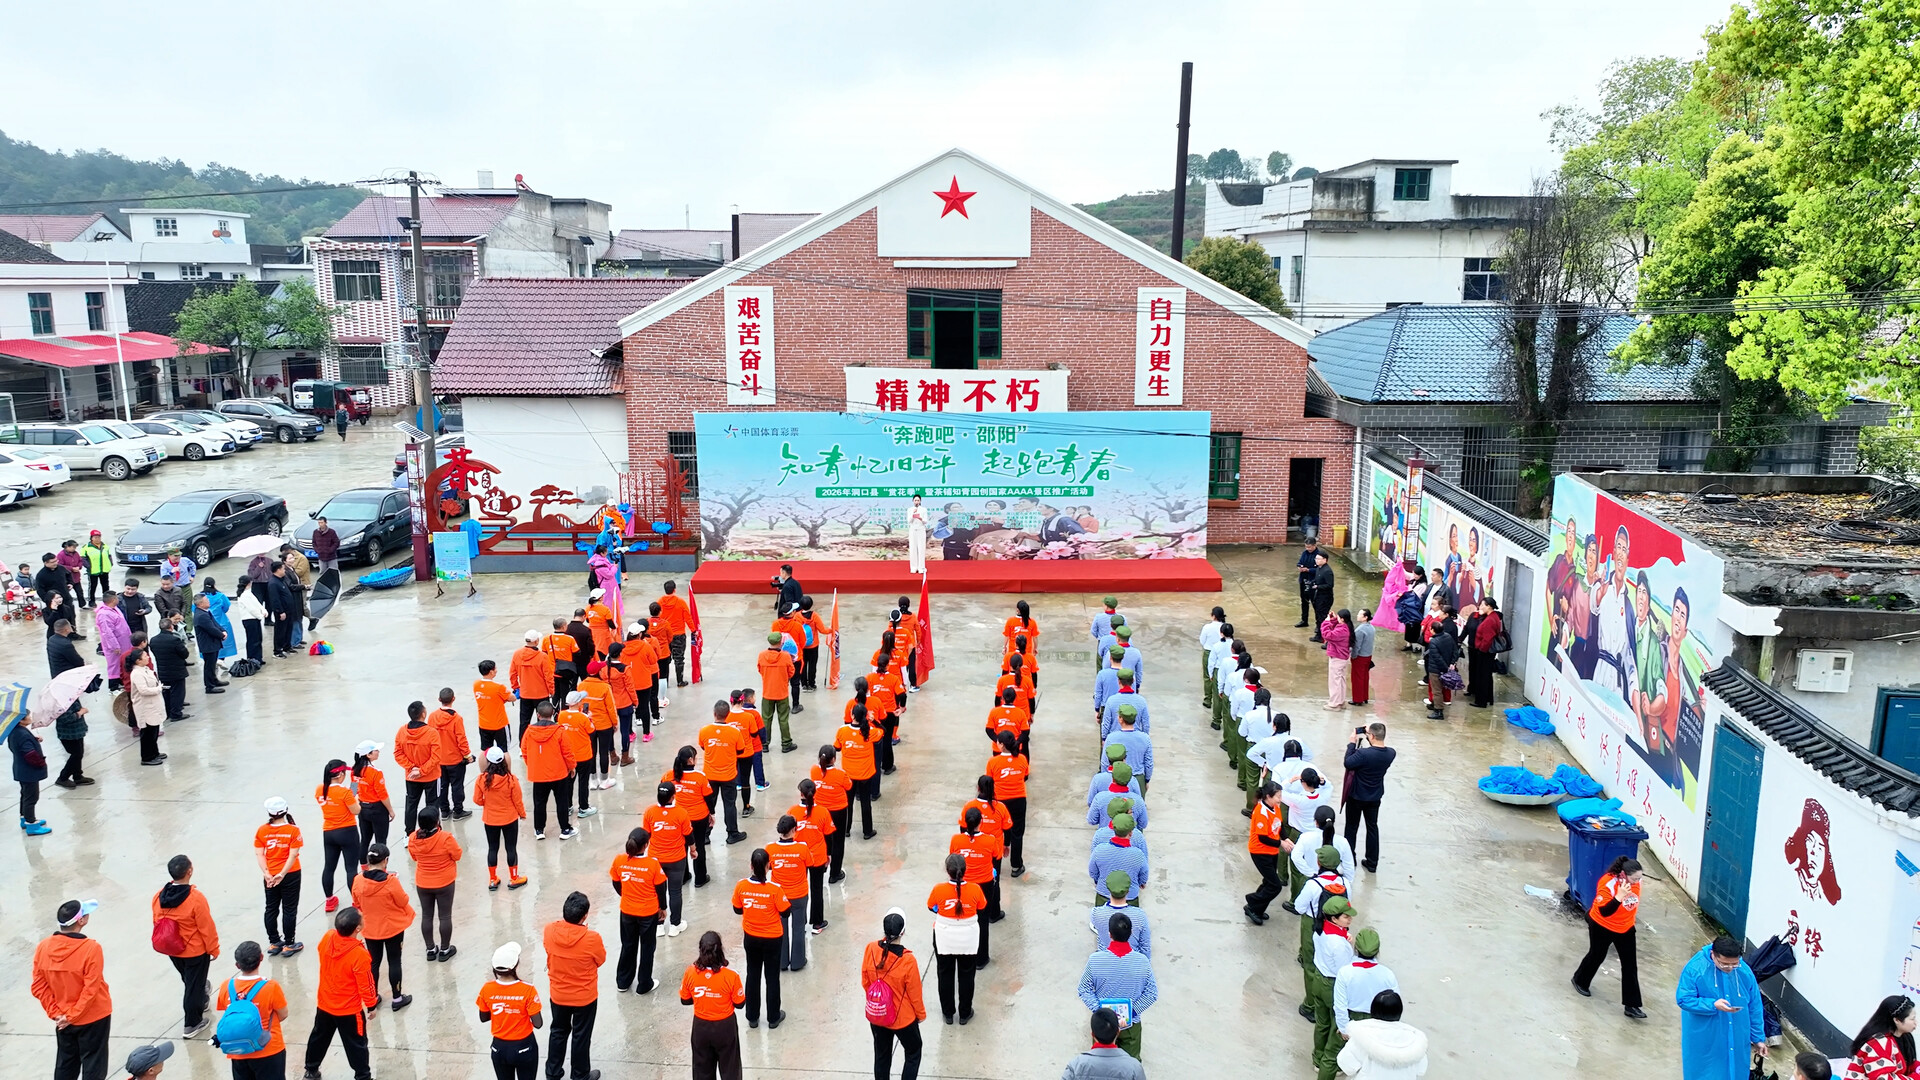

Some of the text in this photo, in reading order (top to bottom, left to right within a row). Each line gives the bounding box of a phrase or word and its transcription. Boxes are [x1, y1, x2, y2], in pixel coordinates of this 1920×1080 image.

[736, 296, 763, 396] 艰苦奋斗
[1148, 297, 1172, 397] 自力更生
[875, 378, 1041, 412] 精神不朽
[741, 427, 799, 437] 中国体育彩票
[443, 447, 485, 492] 茶
[777, 442, 1133, 486] 知青忆旧坪 起跑青春
[483, 491, 508, 515] 道
